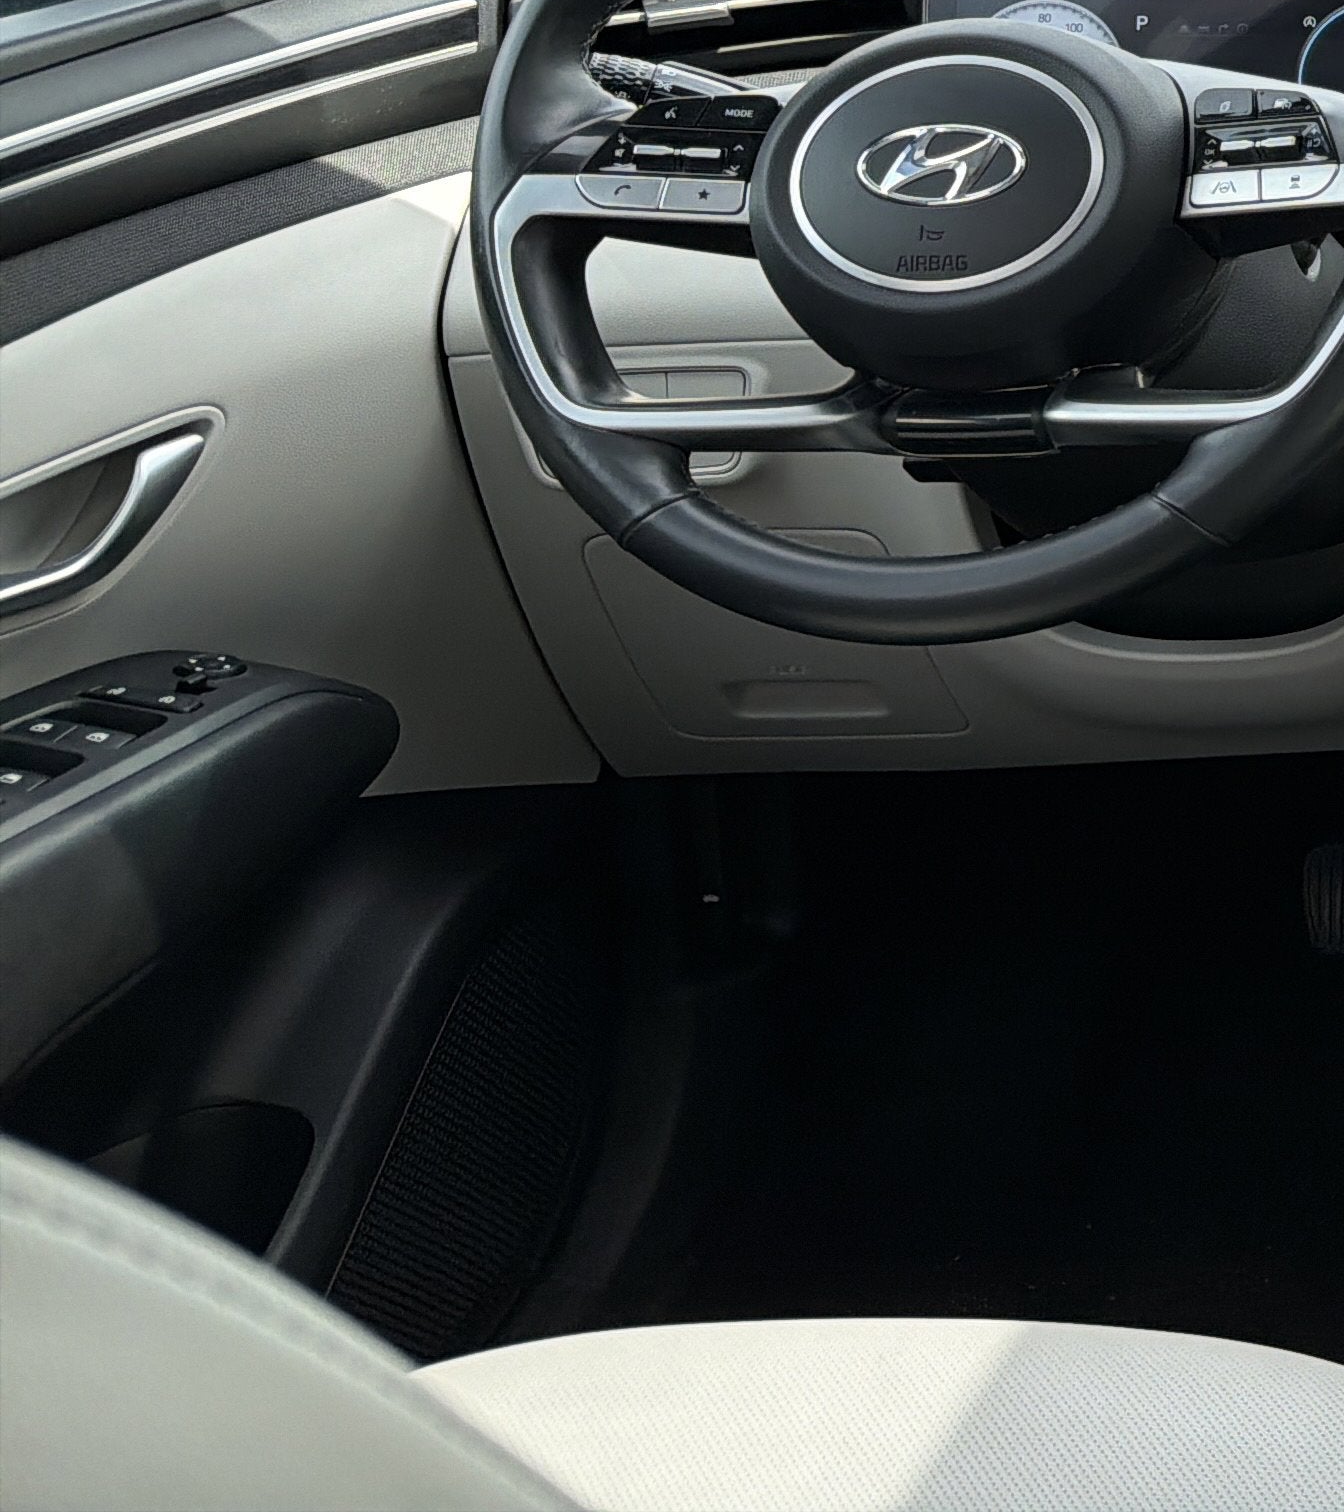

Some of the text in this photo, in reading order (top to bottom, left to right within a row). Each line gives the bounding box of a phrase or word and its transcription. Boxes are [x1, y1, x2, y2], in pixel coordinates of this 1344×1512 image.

[1038, 13, 1052, 23] 80
[1065, 23, 1083, 33] 100
[1136, 16, 1149, 31] P
[724, 109, 754, 118] MODE
[895, 254, 968, 273] AIRBAG
